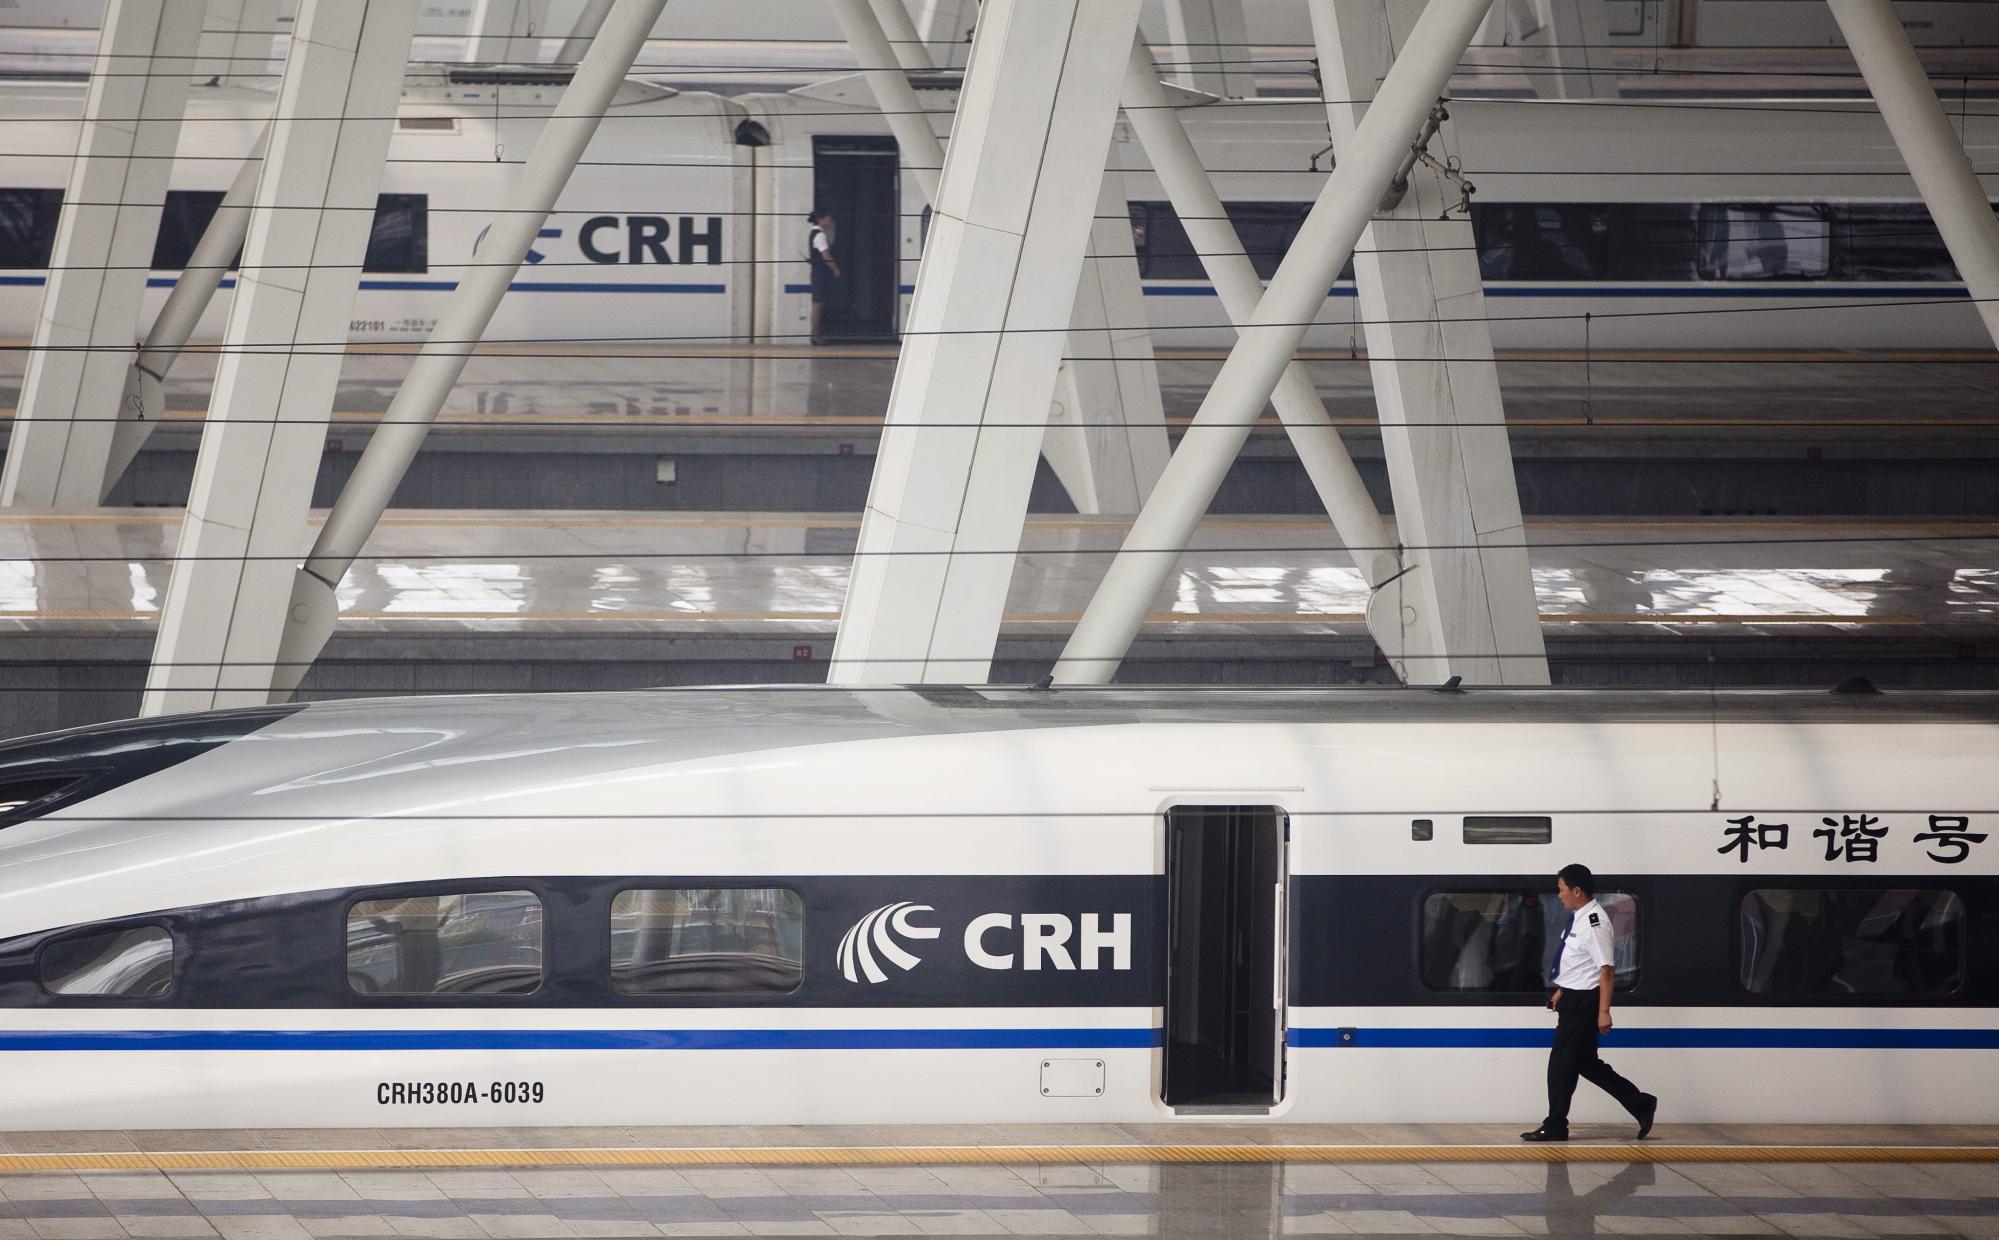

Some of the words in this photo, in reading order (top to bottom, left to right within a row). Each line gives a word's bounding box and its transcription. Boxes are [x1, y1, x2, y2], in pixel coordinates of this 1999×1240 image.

[578, 215, 723, 265] CRH
[1717, 814, 1989, 864] 和谐号
[963, 912, 1132, 971] CRH
[376, 1081, 544, 1105] CRH380A-6039
